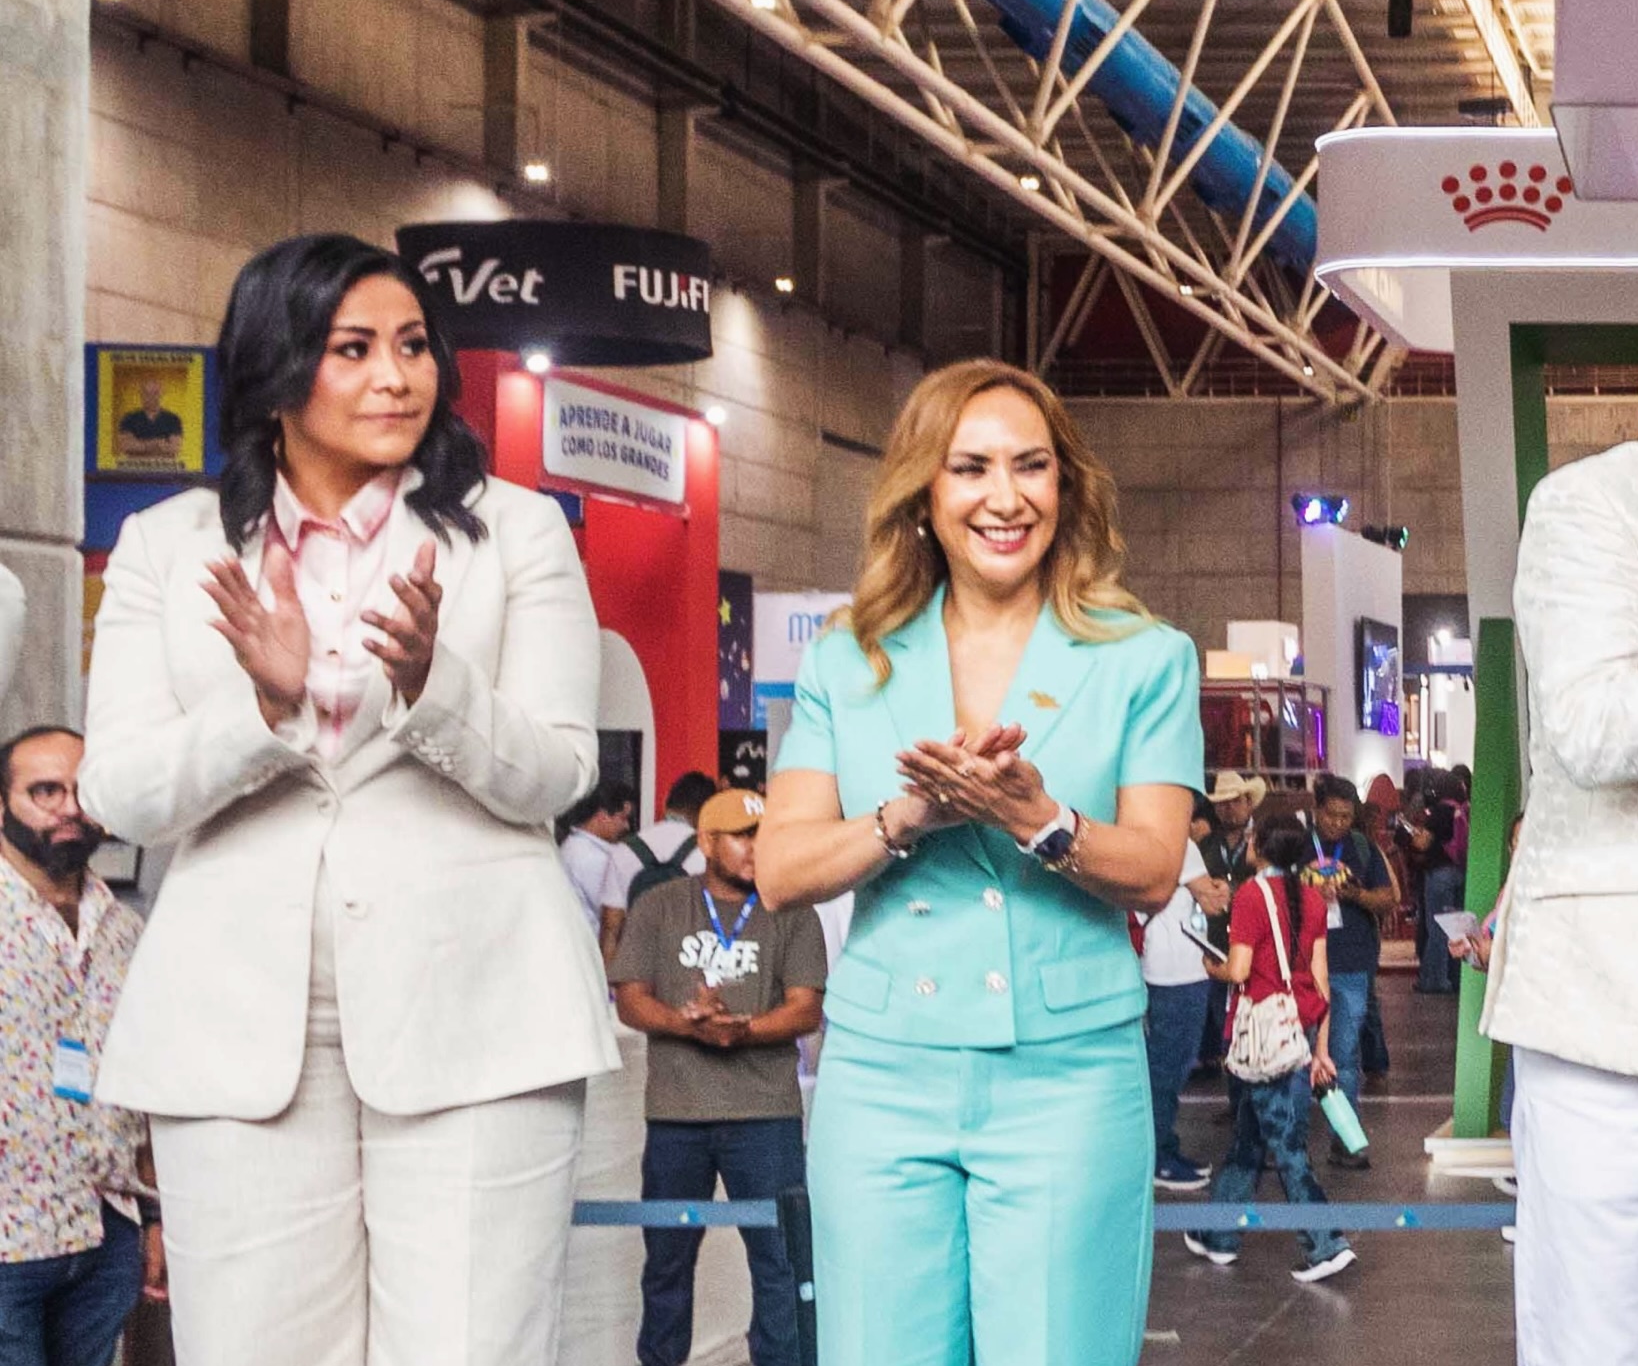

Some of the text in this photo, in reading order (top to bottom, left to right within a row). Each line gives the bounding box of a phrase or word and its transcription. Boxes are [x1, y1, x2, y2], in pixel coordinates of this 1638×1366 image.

[560, 404, 672, 455] APRENDE A JUGAR
[562, 436, 670, 481] COMO LOS GRANDES
